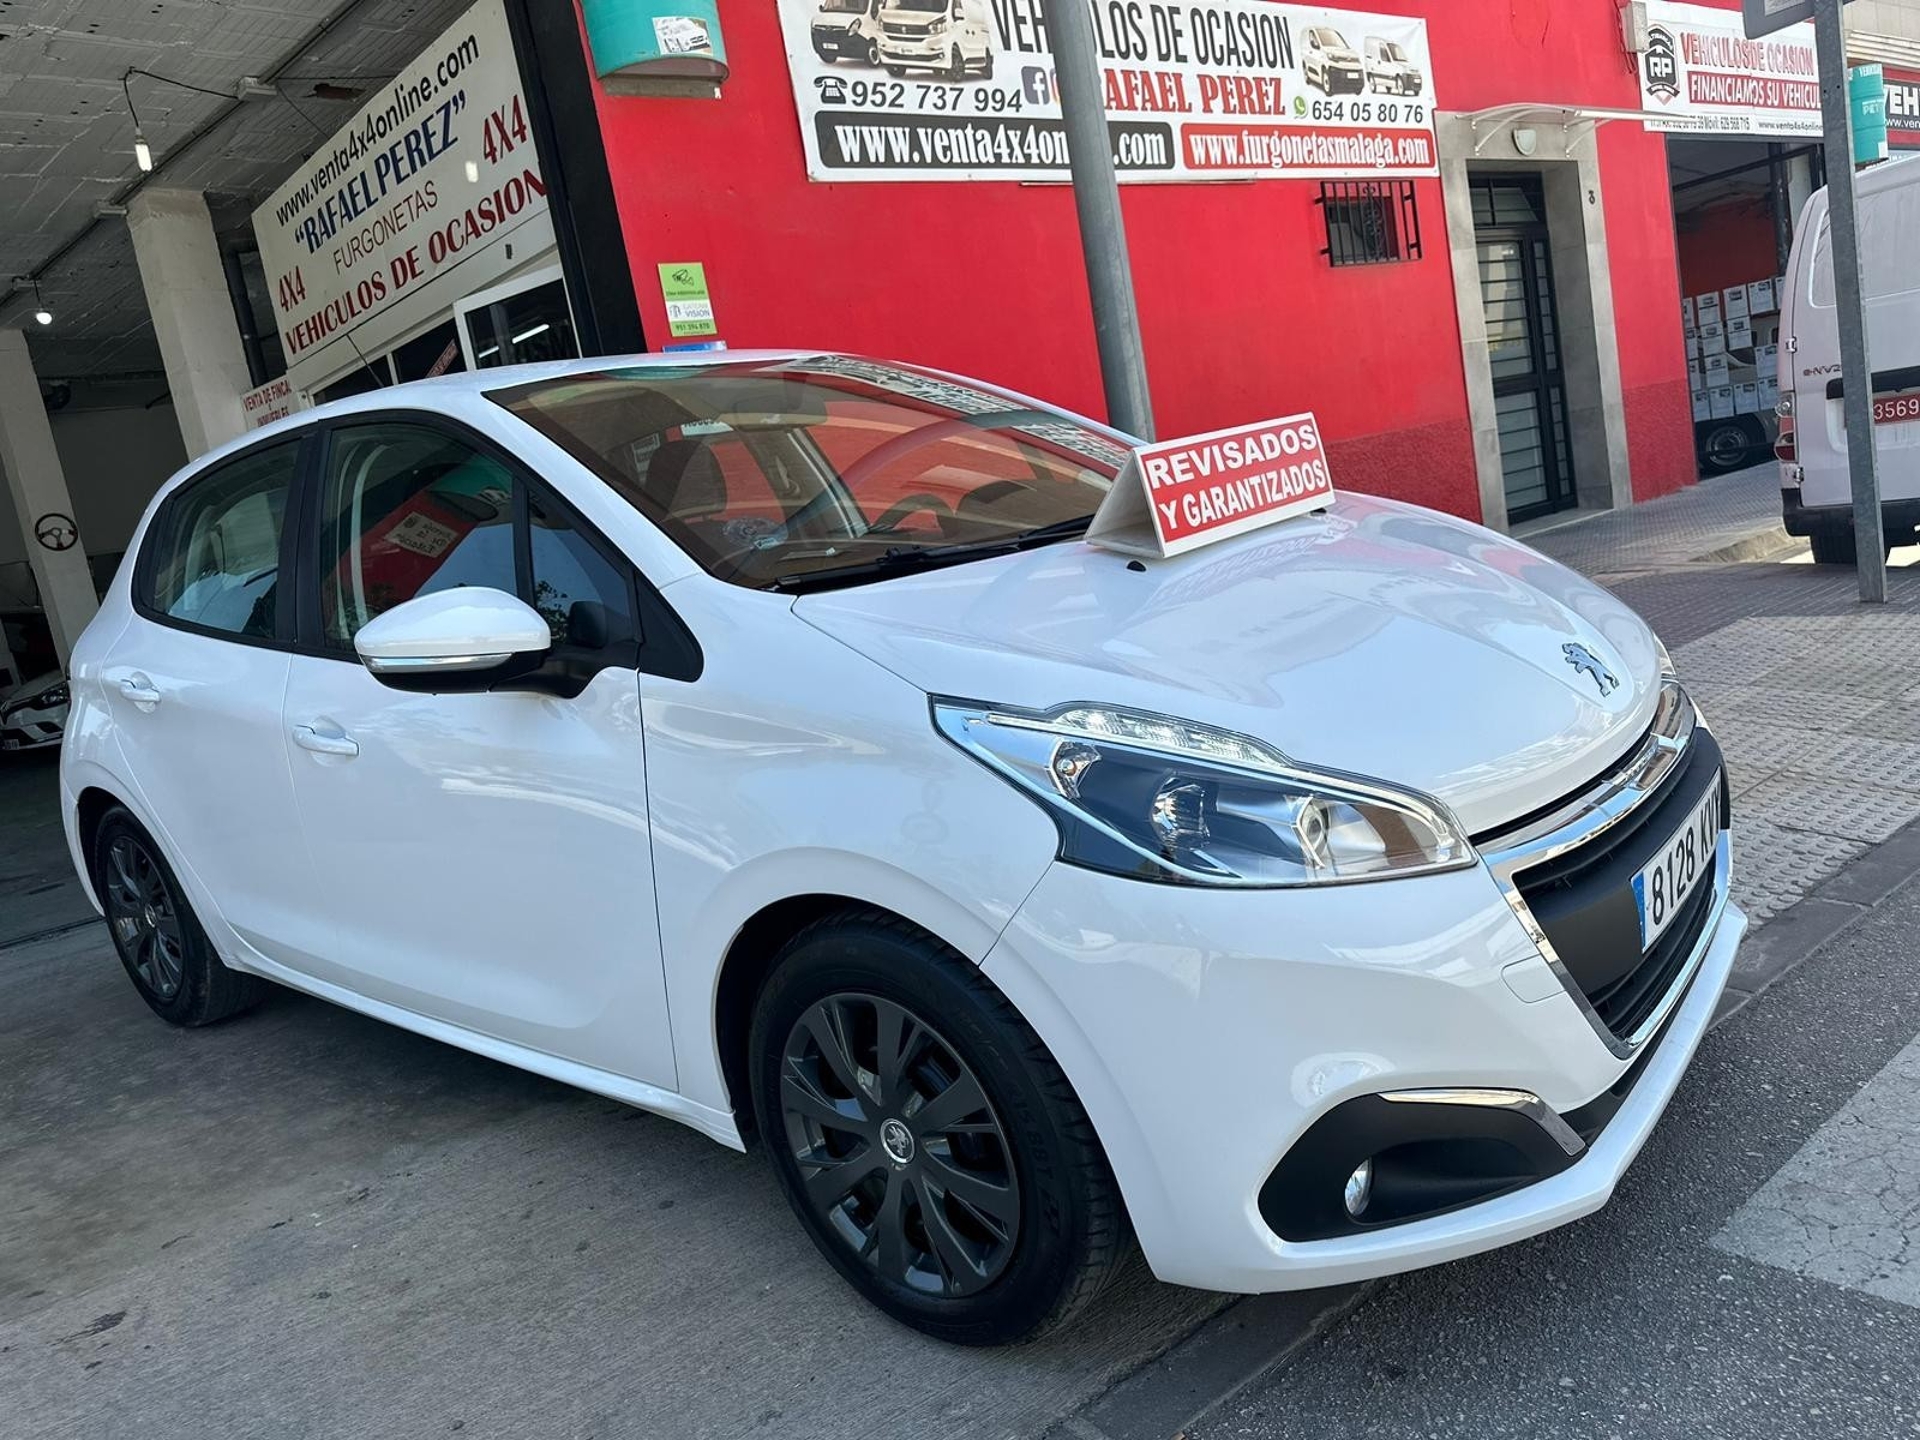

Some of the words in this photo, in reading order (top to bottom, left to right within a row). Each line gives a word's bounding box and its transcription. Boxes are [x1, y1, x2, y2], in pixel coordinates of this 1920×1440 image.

[991, 0, 1147, 61] VEHLOS
[1150, 4, 1188, 62] DE
[1191, 7, 1295, 69] OCASION
[1680, 31, 1750, 68] VEHICULOS
[1750, 42, 1766, 72] DE
[1766, 43, 1815, 76] OCASION
[1649, 56, 1674, 78] RP
[851, 80, 905, 109] 952
[916, 84, 965, 111] 737
[974, 87, 1023, 113] 994
[1103, 68, 1193, 113] AFAEL
[1198, 74, 1286, 116] PEREZ
[1312, 100, 1344, 121] 654
[1350, 102, 1372, 122] 05
[1378, 104, 1398, 123] 80
[1404, 104, 1424, 123] 76
[1691, 75, 1765, 106] FINANCIAMOS
[1767, 82, 1780, 107] SU
[1781, 84, 1822, 109] VEHICUL
[276, 33, 480, 227] www.venta4x4online.com
[482, 94, 528, 165] 4X4
[834, 122, 1167, 165] www.venta4x4on.com
[1189, 129, 1431, 168] www.furgonetasmalaga.com
[333, 180, 438, 275] FURGONETAS
[285, 270, 387, 355] VEHICULOS
[390, 246, 425, 290] DE
[428, 168, 550, 264] OCASION
[278, 265, 306, 313] 4X4
[1803, 365, 1842, 377] e-NV2
[1873, 399, 1920, 420] 3569
[1145, 424, 1317, 490] REVISADOS
[1158, 500, 1179, 531] Y
[1182, 459, 1327, 528] GARANTIZADOS
[1652, 827, 1695, 926] 8128
